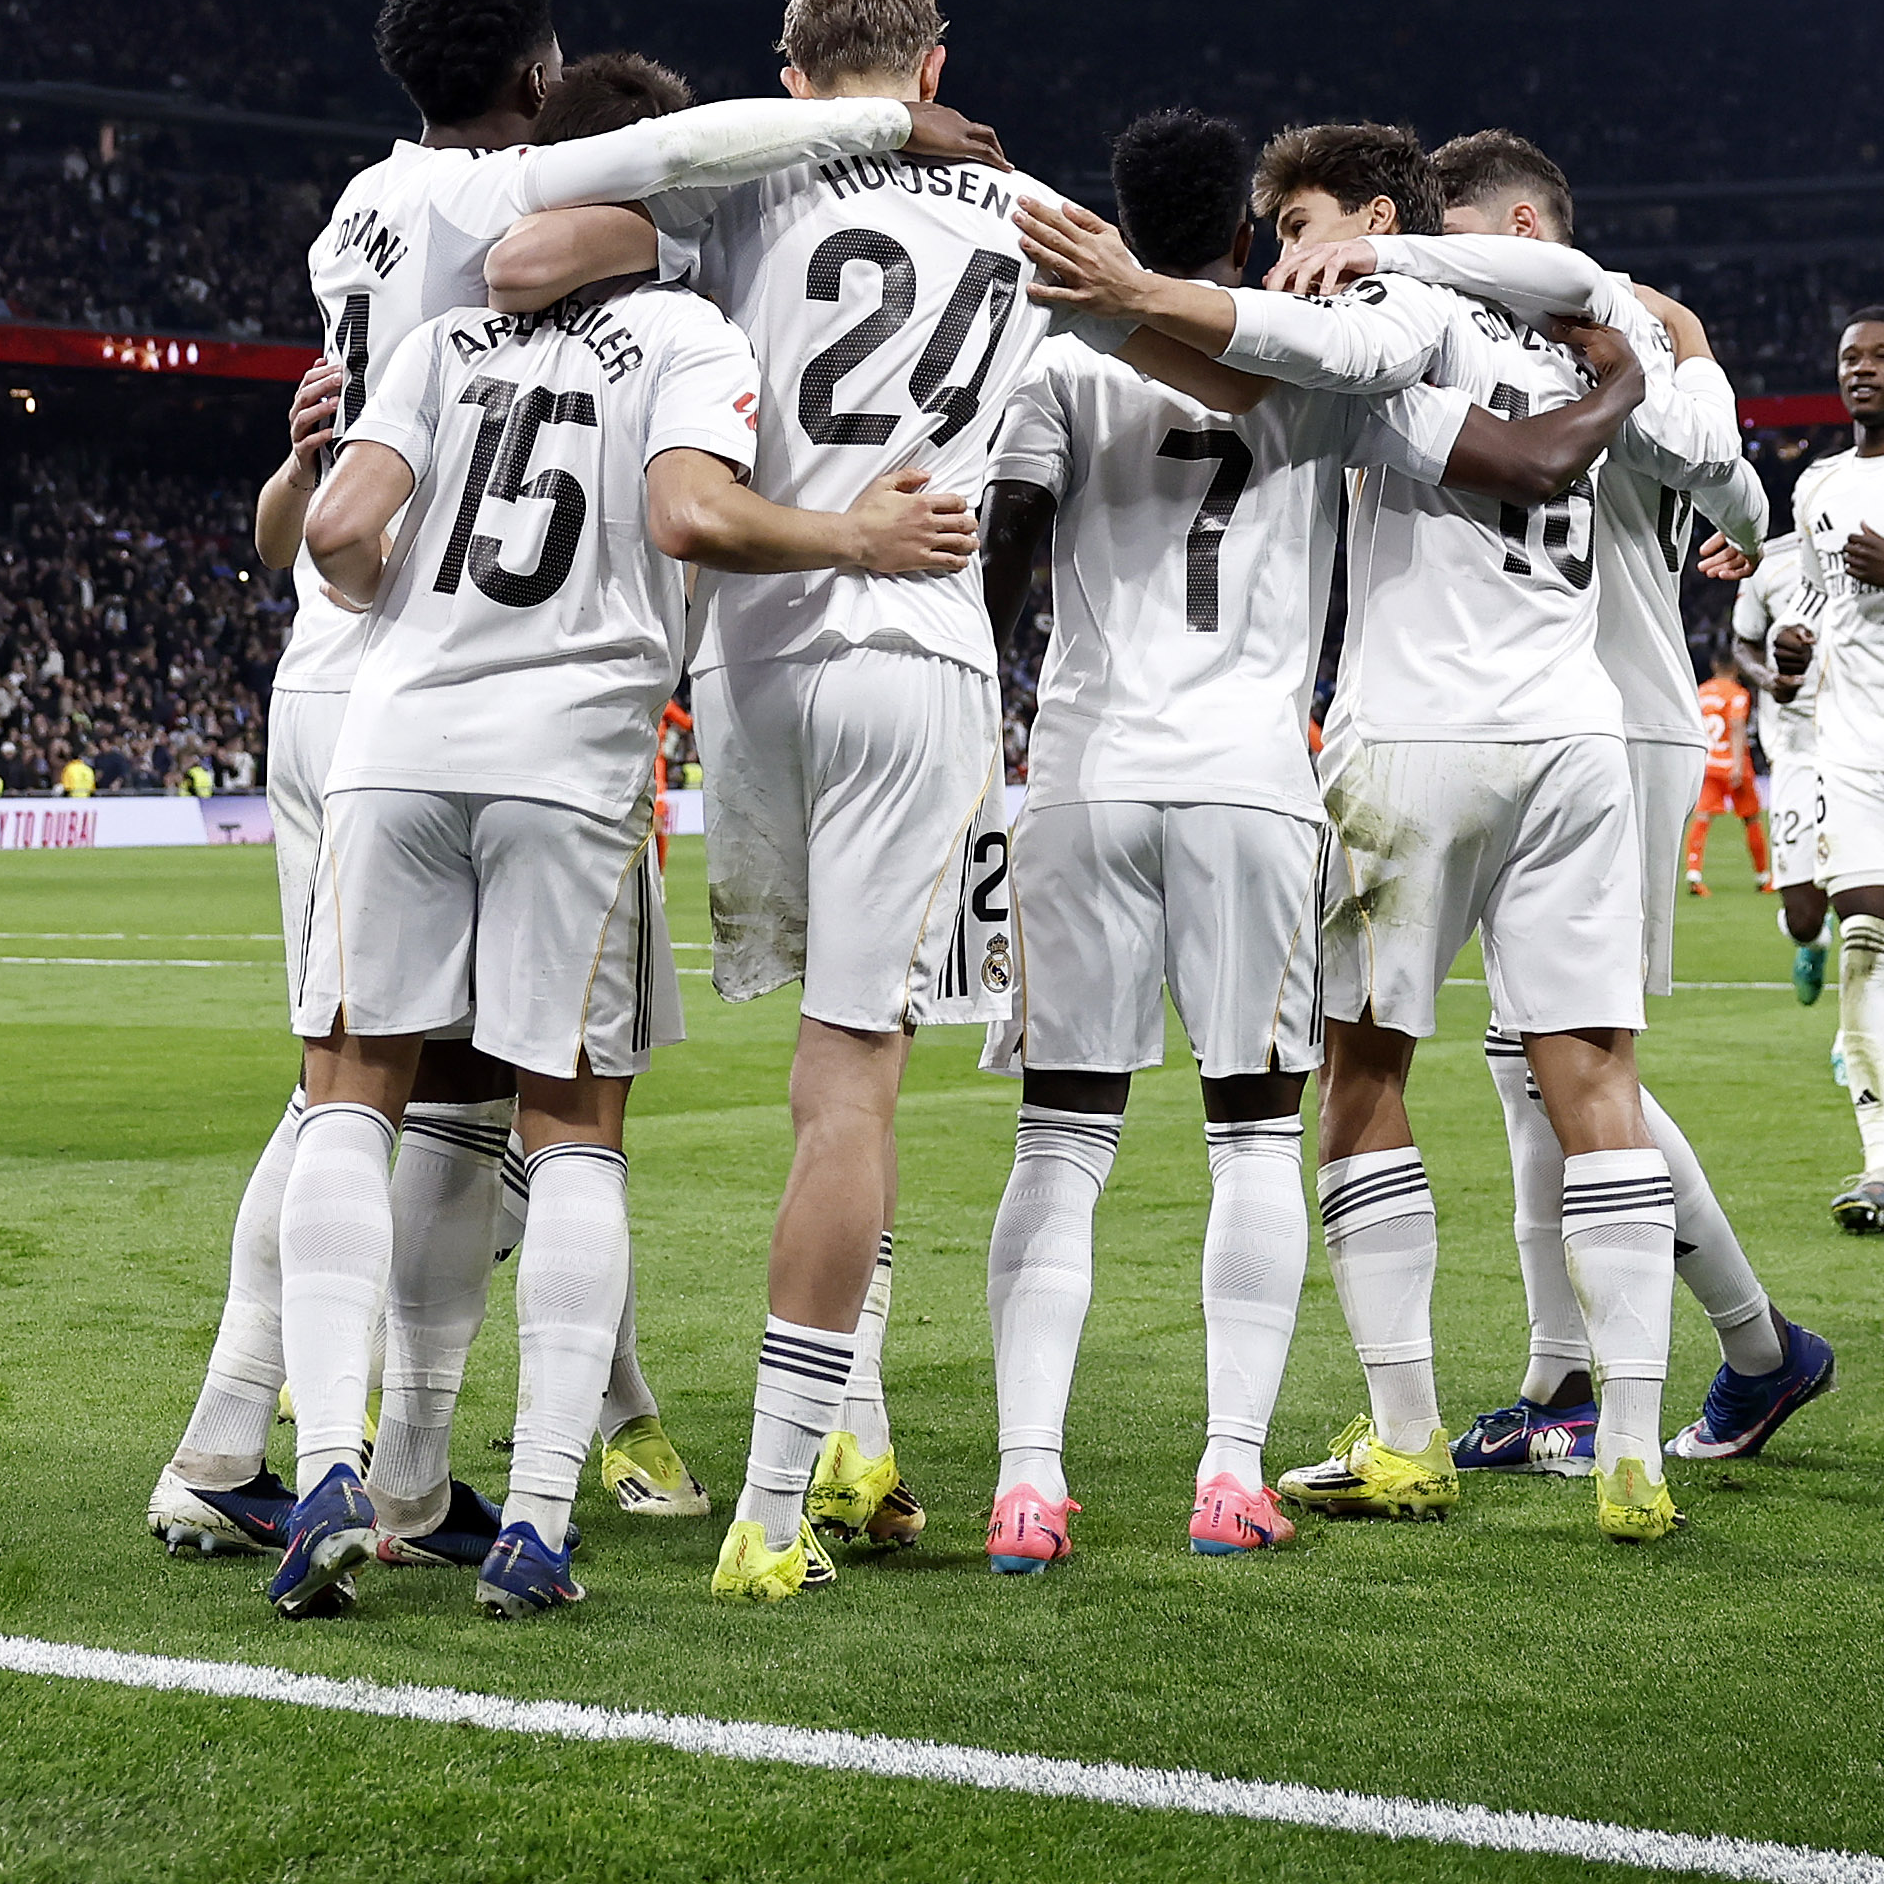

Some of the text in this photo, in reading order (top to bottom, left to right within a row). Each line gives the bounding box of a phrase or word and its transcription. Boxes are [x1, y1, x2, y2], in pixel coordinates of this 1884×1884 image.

[818, 155, 1012, 221] HUIJSEN
[798, 227, 1029, 448] 24
[432, 374, 597, 608] 15
[1156, 428, 1254, 633] 7
